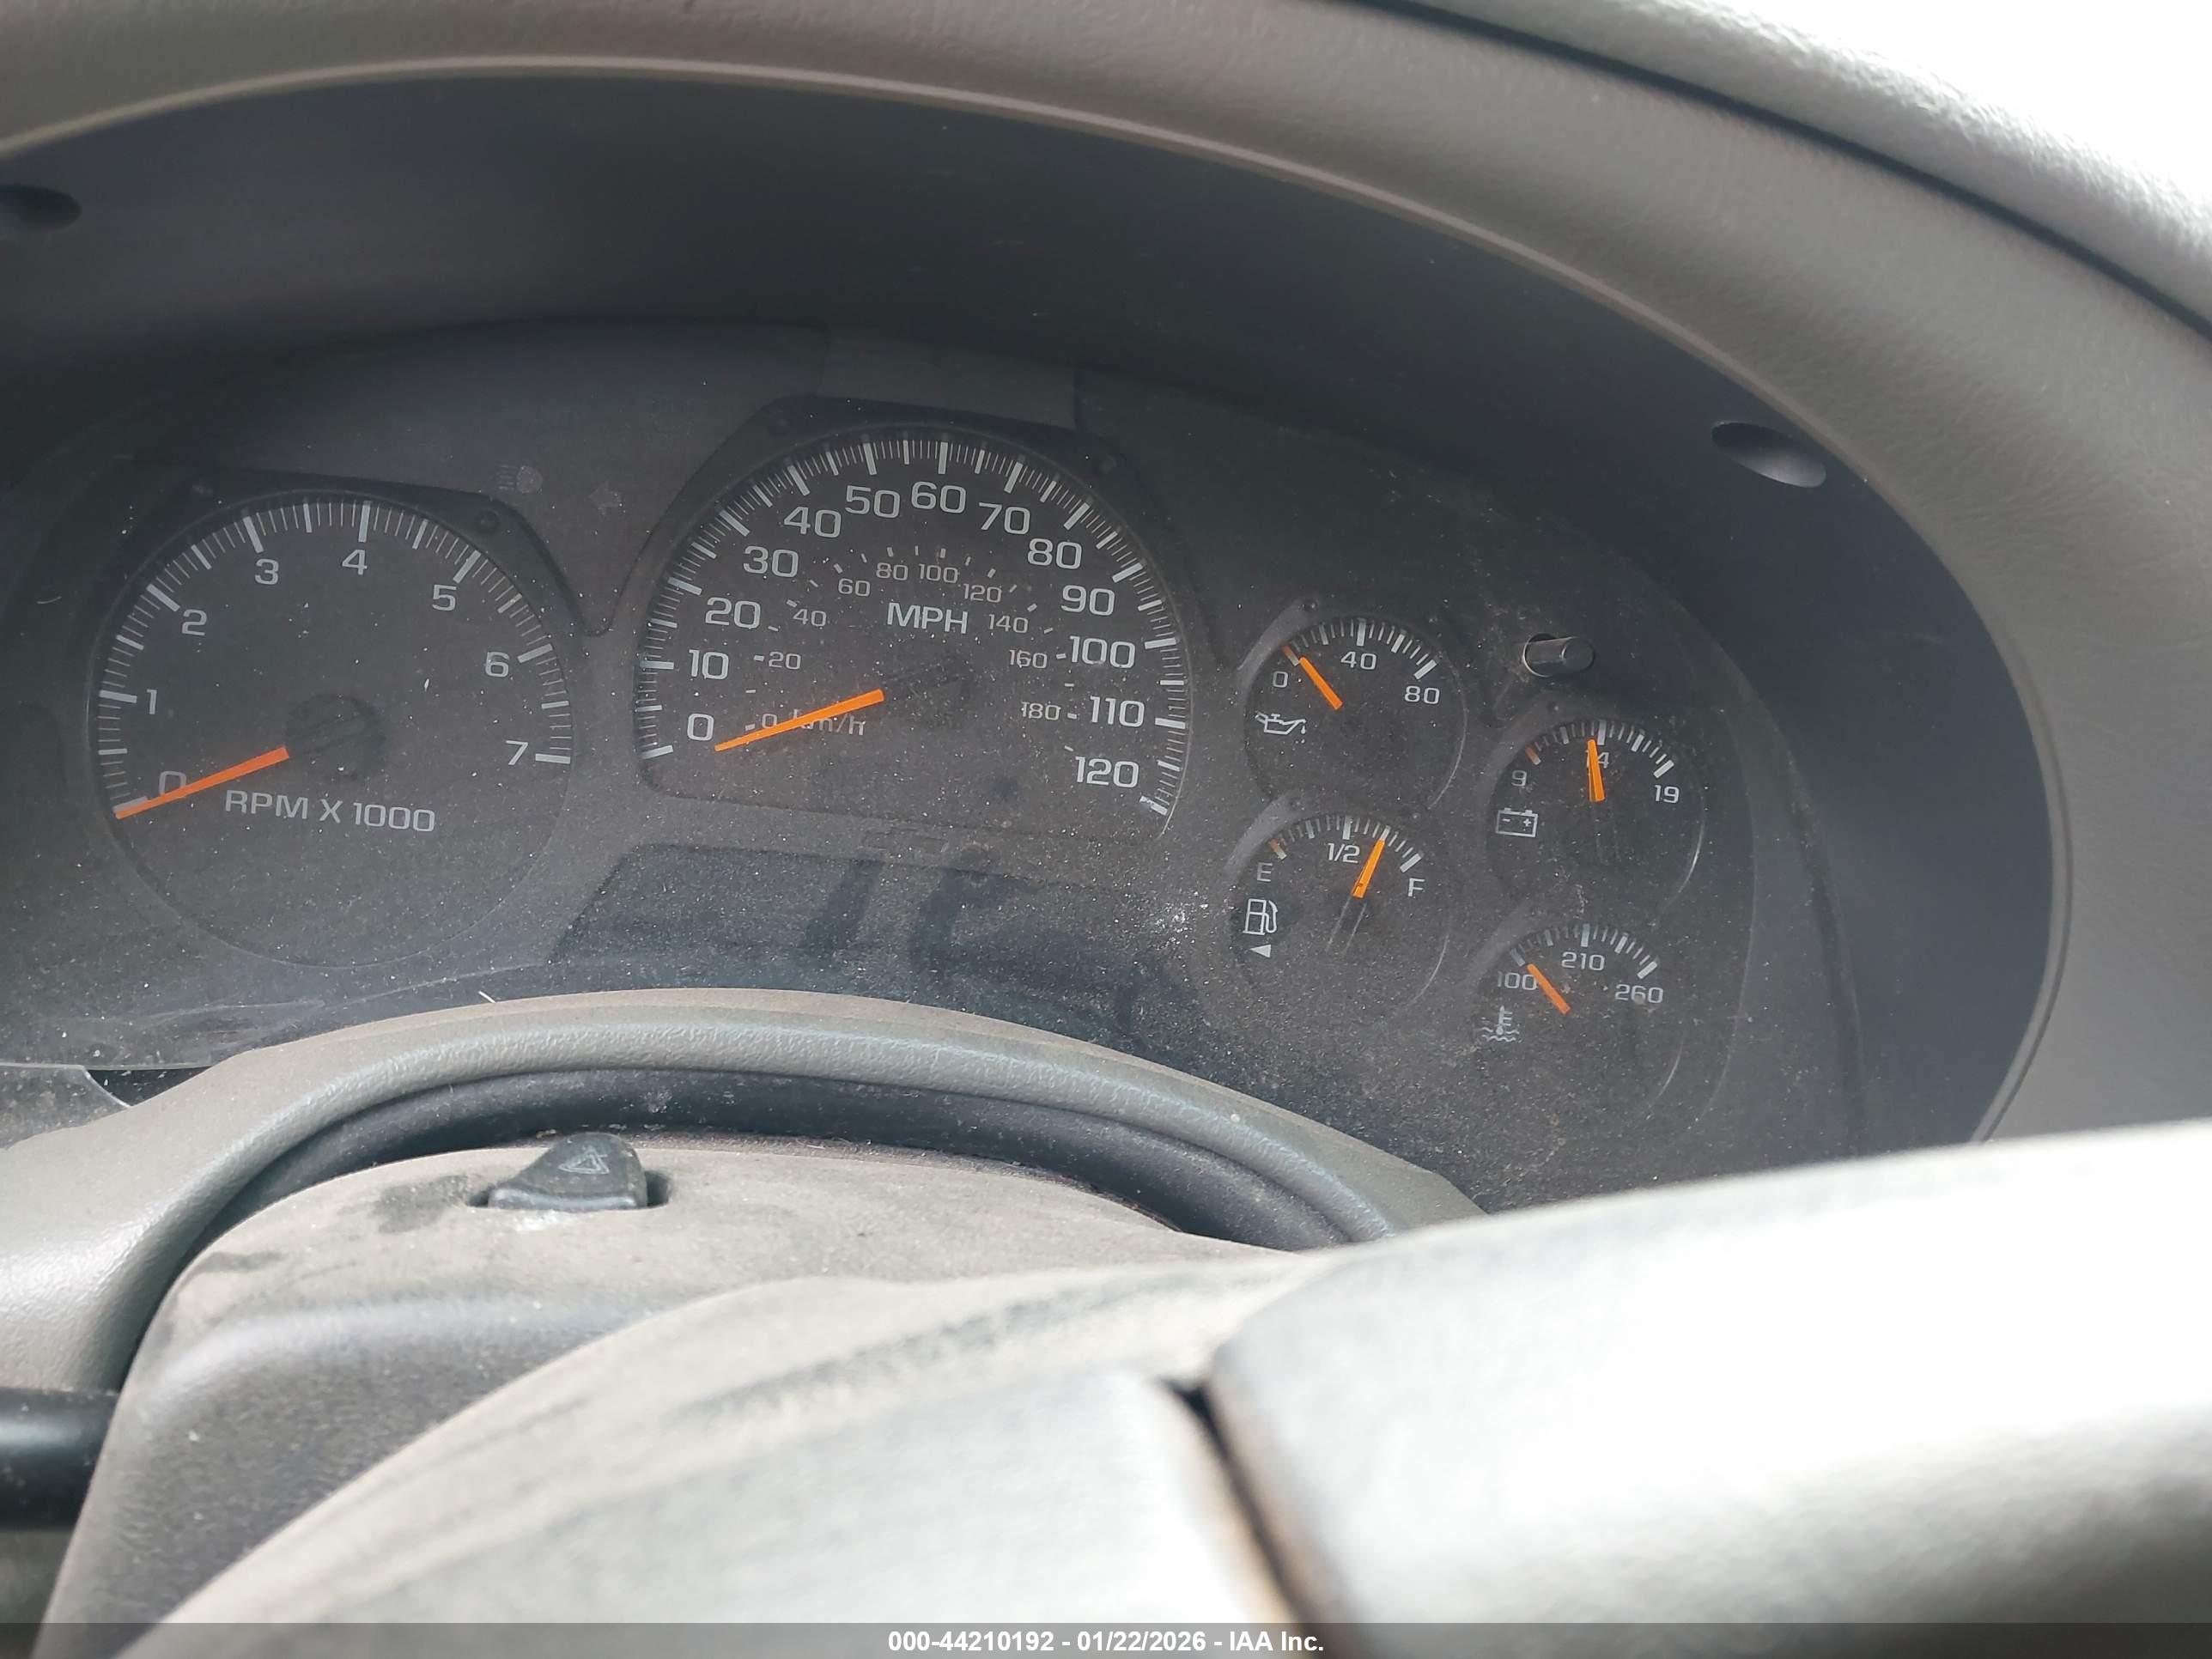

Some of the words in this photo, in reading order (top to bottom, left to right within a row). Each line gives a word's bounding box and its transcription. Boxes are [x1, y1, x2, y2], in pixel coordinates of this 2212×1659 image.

[845, 485, 901, 519] 50
[911, 481, 966, 514] 60
[784, 506, 842, 538] 40
[978, 501, 1030, 535] 70
[343, 550, 368, 575] 4
[743, 545, 799, 578] 30
[1027, 538, 1082, 569] 80
[255, 559, 278, 585] 3
[876, 562, 908, 581] 80
[918, 563, 959, 584] 100
[432, 584, 458, 611] 5
[838, 578, 871, 597] 60
[963, 583, 1002, 603] 120
[705, 597, 761, 629] 20
[1060, 585, 1115, 617] 90
[182, 609, 207, 636] 2
[793, 608, 827, 627] 40
[887, 602, 968, 635] MPH
[988, 613, 1029, 634] 140
[688, 649, 729, 680] 10
[769, 651, 802, 671] 20
[1009, 649, 1048, 669] 160
[1069, 635, 1136, 669] 100
[1340, 651, 1377, 671] 40
[485, 652, 509, 678] 6
[1273, 671, 1289, 688] 0
[146, 690, 157, 715] 1
[1404, 685, 1440, 704] 80
[1021, 701, 1061, 720] 180
[1090, 696, 1145, 727] 110
[687, 713, 714, 741] 0
[505, 740, 528, 765] 7
[1075, 756, 1139, 789] 120
[1511, 769, 1527, 787] 9
[1654, 784, 1680, 804] 19
[225, 789, 309, 820] RPM
[319, 799, 342, 824] X
[353, 802, 435, 833] 1000
[1328, 842, 1360, 864] 1/2
[1257, 862, 1273, 882] E
[1408, 878, 1425, 896] F
[1561, 951, 1605, 971] 210
[1497, 971, 1537, 991] 100
[1615, 983, 1663, 1004] 260
